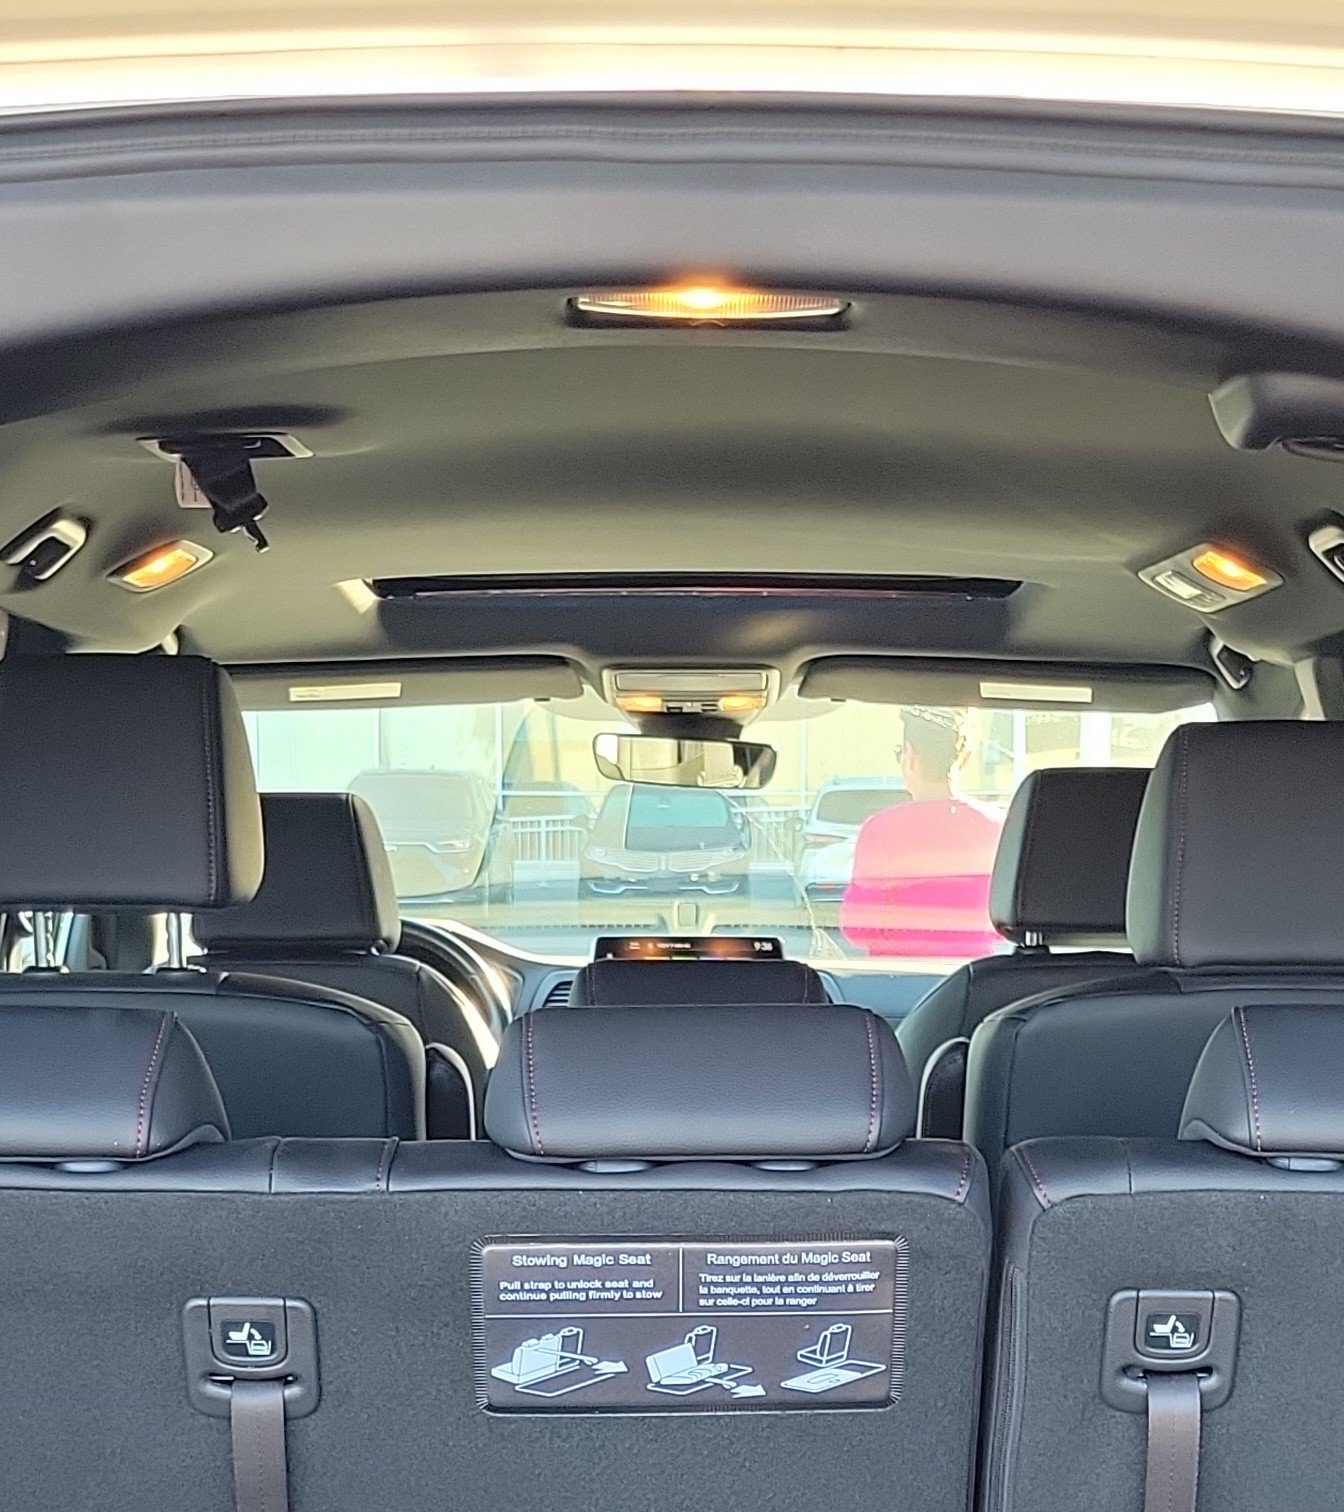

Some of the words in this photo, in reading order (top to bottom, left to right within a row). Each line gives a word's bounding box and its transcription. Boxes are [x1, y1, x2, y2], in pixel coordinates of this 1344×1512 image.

[512, 1254, 567, 1268] Stowing
[573, 1253, 615, 1268] Magic
[618, 1253, 652, 1265] Seat
[707, 1252, 780, 1267] Rangement
[782, 1252, 798, 1265] du
[801, 1251, 839, 1266] Magic
[841, 1251, 871, 1263] Seat
[698, 1273, 724, 1283] Tirez
[725, 1274, 741, 1282] sur
[742, 1273, 752, 1282] la
[753, 1273, 786, 1282] lanière
[787, 1272, 805, 1282] afin
[807, 1272, 820, 1281] de
[821, 1270, 880, 1281] déverrouiller
[499, 1281, 521, 1290] Pull
[523, 1281, 552, 1291] strap
[554, 1280, 565, 1289] to
[566, 1279, 603, 1289] unlock
[604, 1279, 629, 1288] seat
[632, 1279, 654, 1288] and
[698, 1285, 709, 1294] la
[710, 1285, 760, 1295] banquette,
[762, 1285, 781, 1294] tout
[782, 1286, 795, 1294] en
[796, 1284, 845, 1293] continuant
[856, 1282, 875, 1292] tirer
[499, 1291, 547, 1300] continue
[550, 1291, 586, 1302] pulling
[588, 1290, 621, 1301] firmly
[622, 1290, 634, 1299] to
[635, 1290, 663, 1299] stow
[698, 1298, 715, 1306] sur
[716, 1297, 750, 1306] celle-ci
[751, 1297, 774, 1308] pour
[775, 1296, 784, 1305] la
[785, 1297, 817, 1307] ranger
